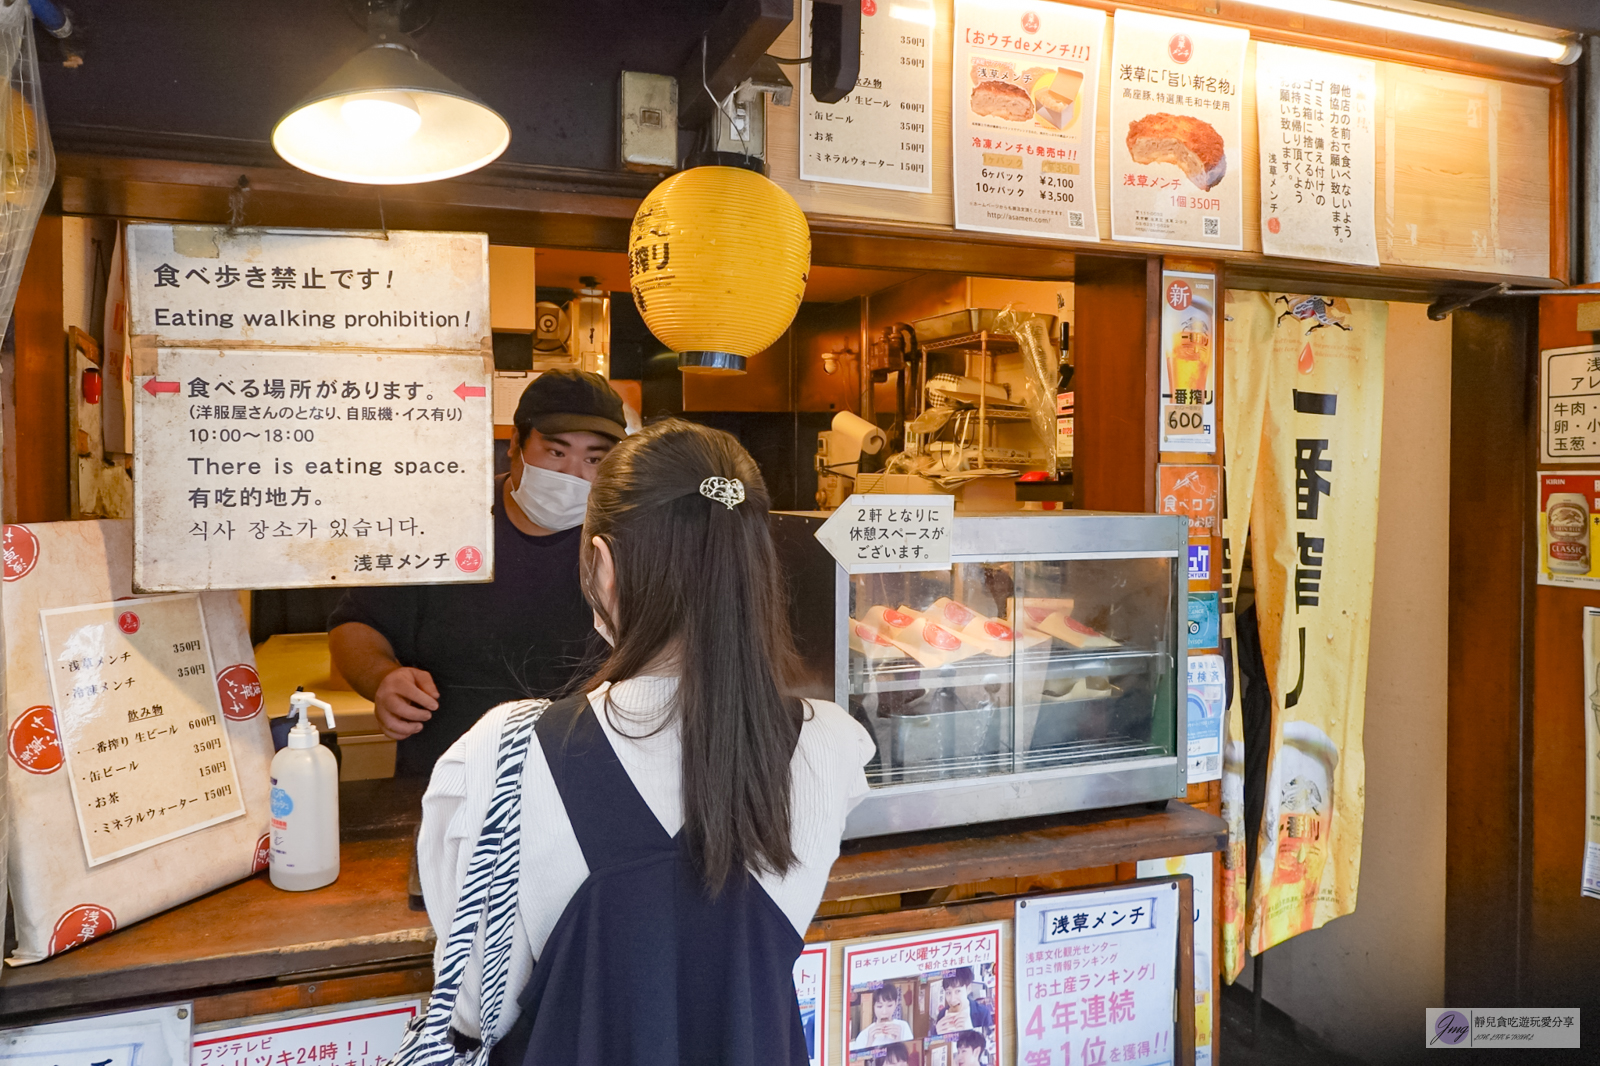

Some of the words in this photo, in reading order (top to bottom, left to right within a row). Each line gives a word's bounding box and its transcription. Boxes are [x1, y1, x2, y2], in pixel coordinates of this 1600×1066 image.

[900, 35, 925, 47] 350円
[900, 57, 925, 69] 350円
[978, 68, 1033, 83] 浅草メンチ
[1119, 63, 1236, 96] 浅草に「旨い新名物」
[900, 102, 925, 113] 600円
[1122, 87, 1230, 112] 高座豚、特選黒毛和牛使用
[900, 122, 925, 134] 350円
[900, 142, 925, 153] 150円
[900, 162, 925, 174] 150円
[1341, 85, 1352, 239] 他店の前で食べないよう
[1123, 173, 1182, 190] 浅草メンチ
[1268, 152, 1279, 213] 浅草メンチ
[1190, 197, 1220, 211] 350円
[1170, 284, 1190, 308] 新
[154, 308, 234, 329] Eating
[243, 309, 336, 329] walking
[344, 310, 471, 330] prohibition!
[187, 377, 435, 401] 食べる場所があります。
[1162, 388, 1213, 405] 一番搾り
[1168, 410, 1203, 430] 600
[188, 457, 261, 475] There
[274, 457, 293, 475] is
[305, 458, 383, 476] eating
[394, 459, 466, 476] space.
[188, 487, 323, 508] 有吃的地方。
[188, 520, 236, 540] 식사
[248, 519, 318, 539] 장소가
[330, 516, 425, 539] 있습니다.
[849, 526, 945, 541] 休憩スペースが
[857, 544, 930, 560] ございます。
[1552, 545, 1583, 554] CLASSIC
[353, 551, 450, 572] 浅草メンチ
[173, 640, 201, 653] 350円
[177, 664, 206, 678] 350円
[127, 704, 164, 722] 飲み物
[134, 725, 179, 743] 生ビール
[188, 715, 217, 730] 600円
[193, 738, 222, 753] 350円
[199, 760, 227, 778] 150円
[204, 784, 232, 802] 150円
[1051, 906, 1145, 936] 浅草メンチ
[855, 937, 991, 968] 日本テレビ「火曜サプライズ」
[1026, 941, 1118, 964] 浅草文化観光センター
[1026, 953, 1118, 978] 口コミ情報ランキング
[1027, 963, 1156, 1002] 「お土産ランキング」
[1025, 989, 1136, 1041] 4年連続
[201, 1037, 273, 1060] フジテレビ
